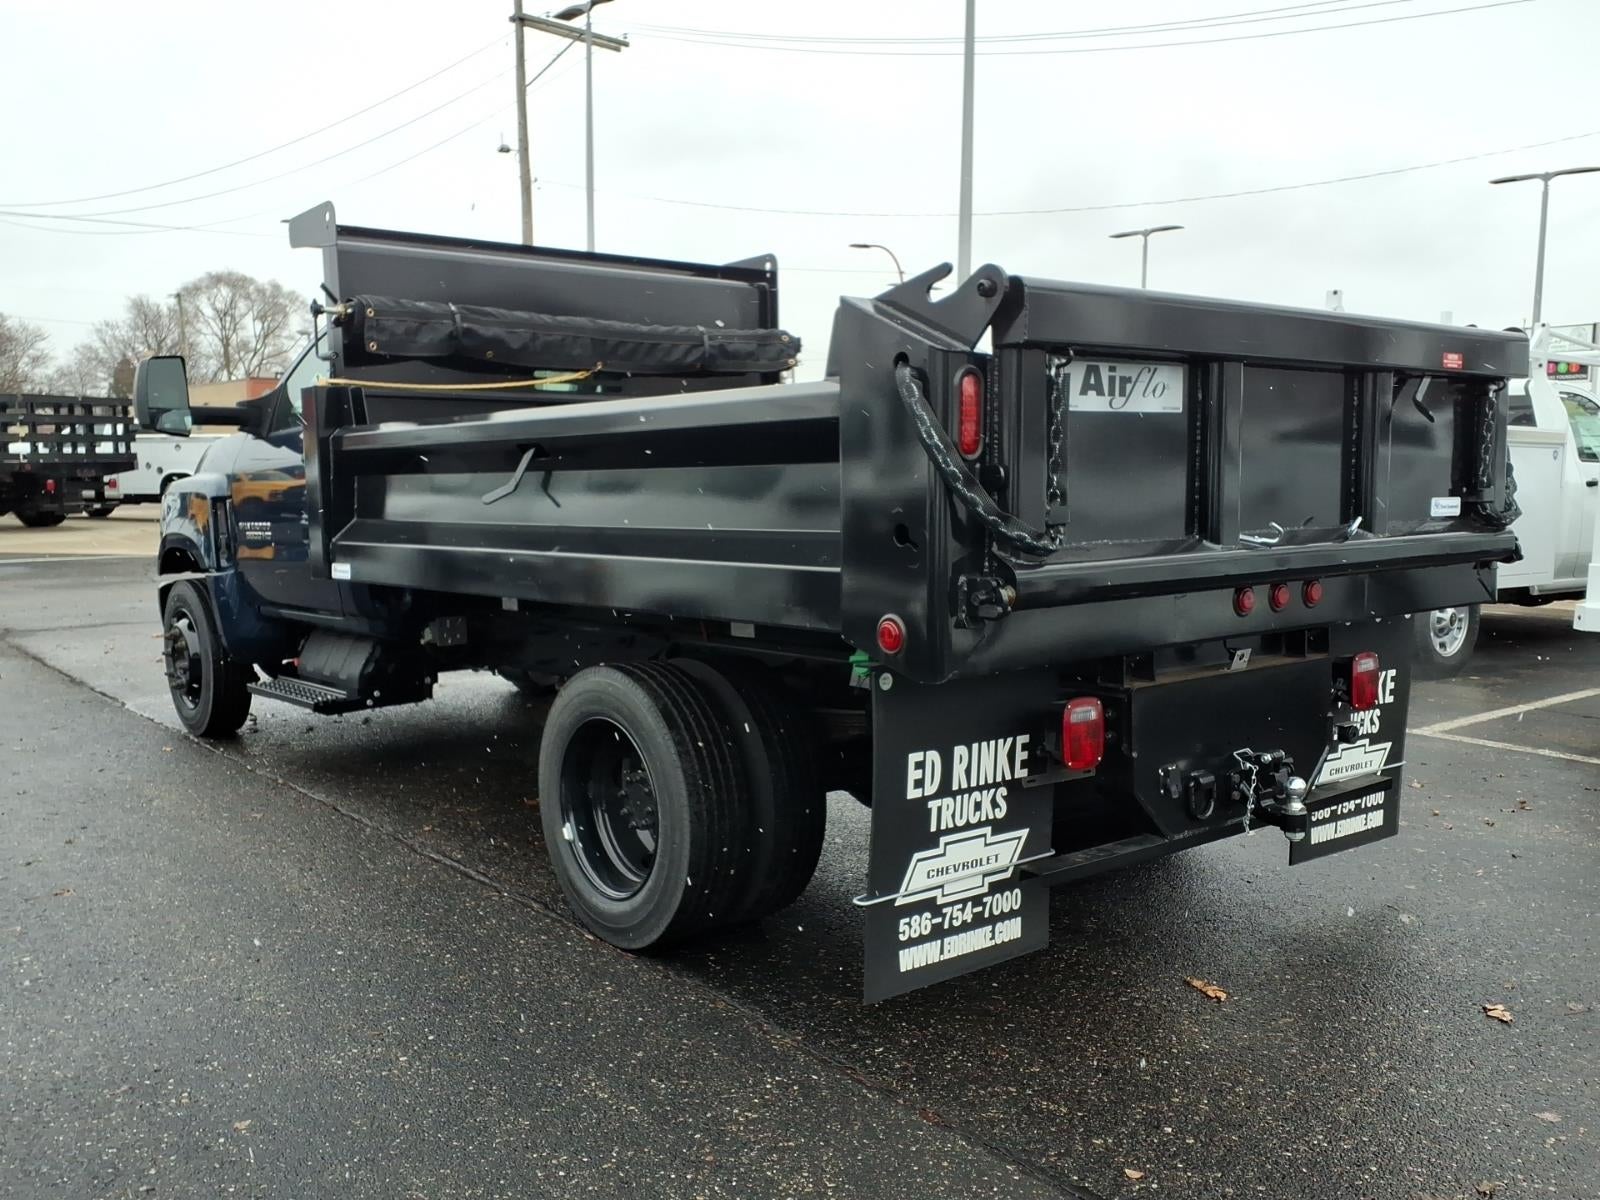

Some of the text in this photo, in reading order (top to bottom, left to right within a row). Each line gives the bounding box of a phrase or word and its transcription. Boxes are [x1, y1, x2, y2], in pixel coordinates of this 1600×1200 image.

[1079, 364, 1166, 409] Airflo
[907, 734, 1030, 800] ED RINKE
[1329, 759, 1373, 777] CHEVROLET
[927, 786, 1008, 832] TRUCKS
[926, 853, 1001, 879] CHEVROLET
[899, 888, 1022, 941] 586-754-7000
[899, 917, 1022, 972] WWW.EDRINKE.COM
